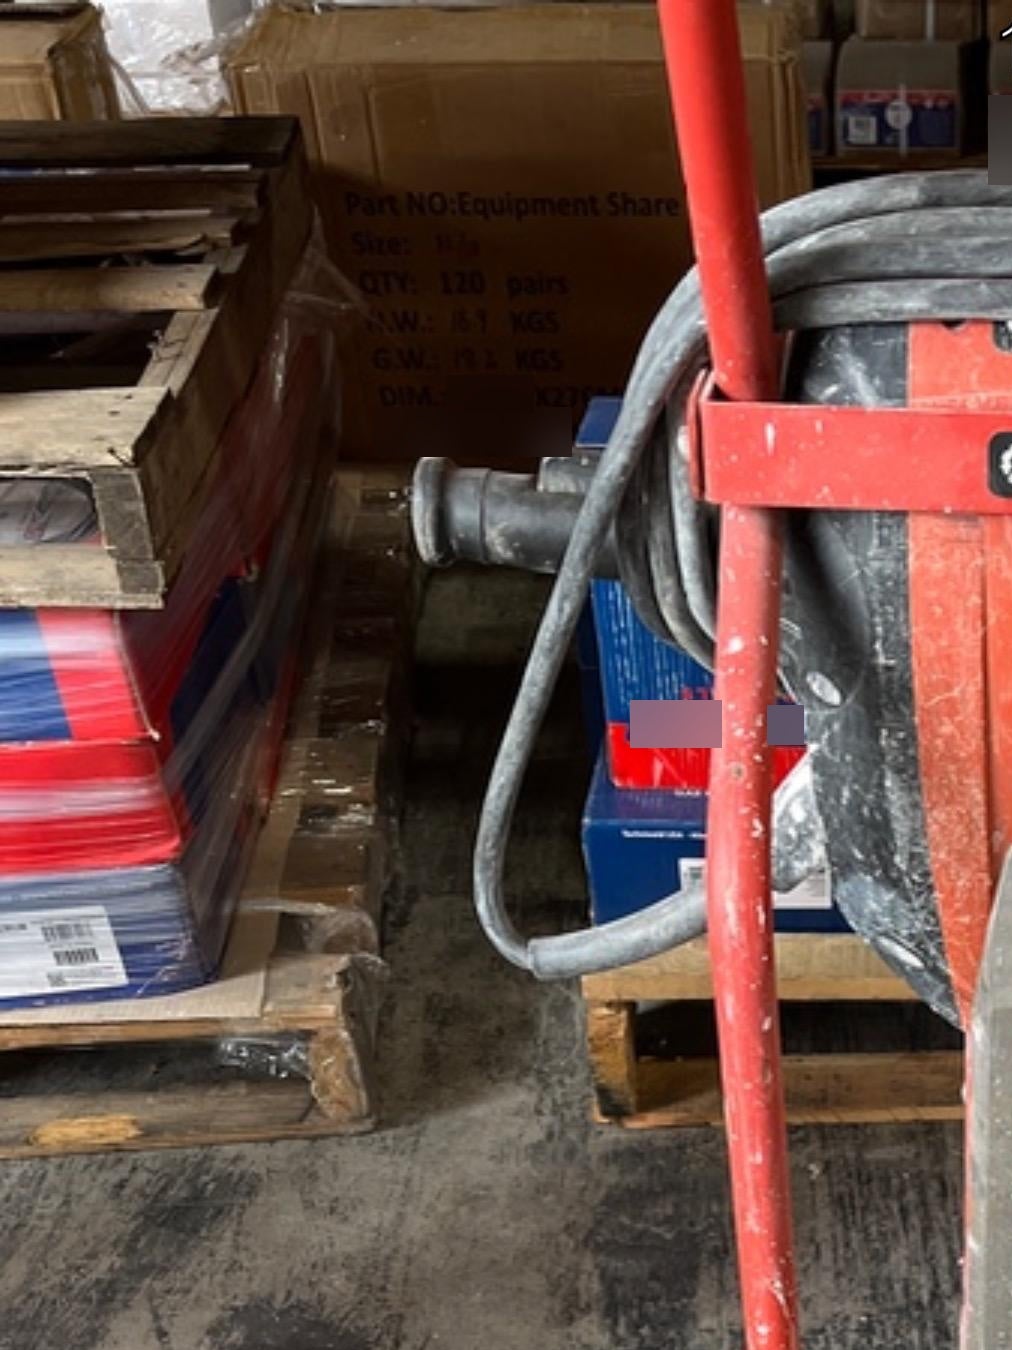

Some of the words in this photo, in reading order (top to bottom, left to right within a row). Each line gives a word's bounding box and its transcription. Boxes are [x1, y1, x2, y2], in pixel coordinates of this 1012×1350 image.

[346, 192, 398, 217] Part
[607, 192, 680, 217] Share
[359, 270, 417, 295] QTY:
[441, 270, 486, 295] 120
[505, 272, 570, 300] pairs
[509, 310, 560, 334] KGS
